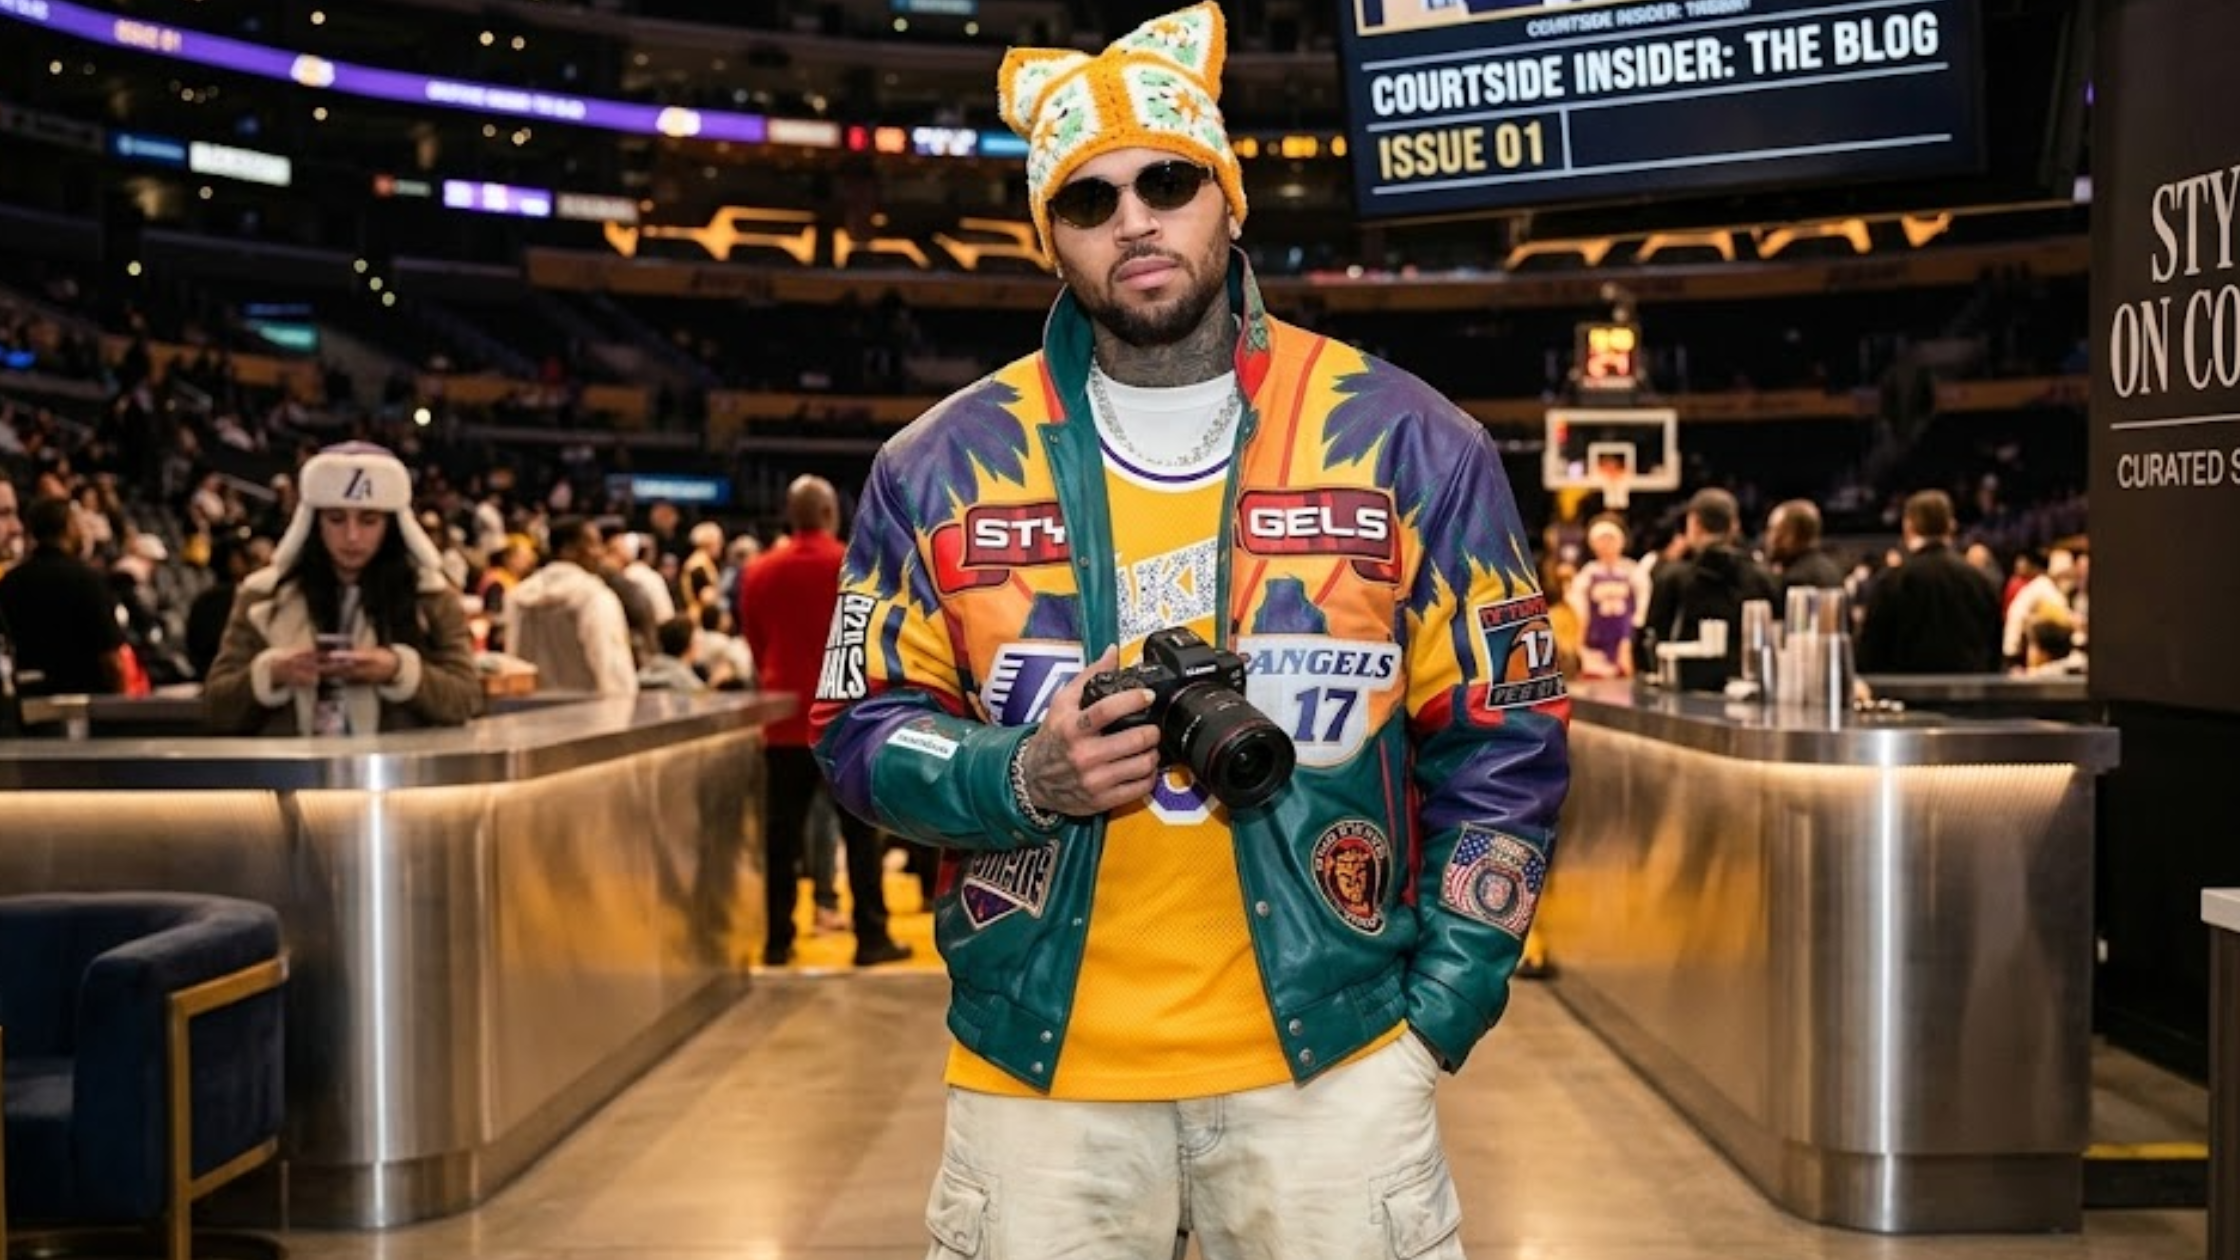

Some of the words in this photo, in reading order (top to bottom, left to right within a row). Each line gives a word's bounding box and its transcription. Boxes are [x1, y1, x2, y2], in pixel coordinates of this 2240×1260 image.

[1371, 57, 1565, 116] COURTSIDE
[1573, 37, 1735, 95] INSIDER:
[1744, 24, 1822, 75] THE
[1833, 10, 1939, 66] BLOG
[1378, 126, 1487, 180] ISSUE
[1495, 119, 1544, 168] 01
[2151, 164, 2240, 283] STY
[2110, 296, 2171, 398] ON
[2183, 284, 2240, 391] CO
[2117, 449, 2224, 488] CURATED
[1249, 506, 1388, 540] GELS
[1521, 630, 1554, 668] 17
[1293, 686, 1358, 742] 17
